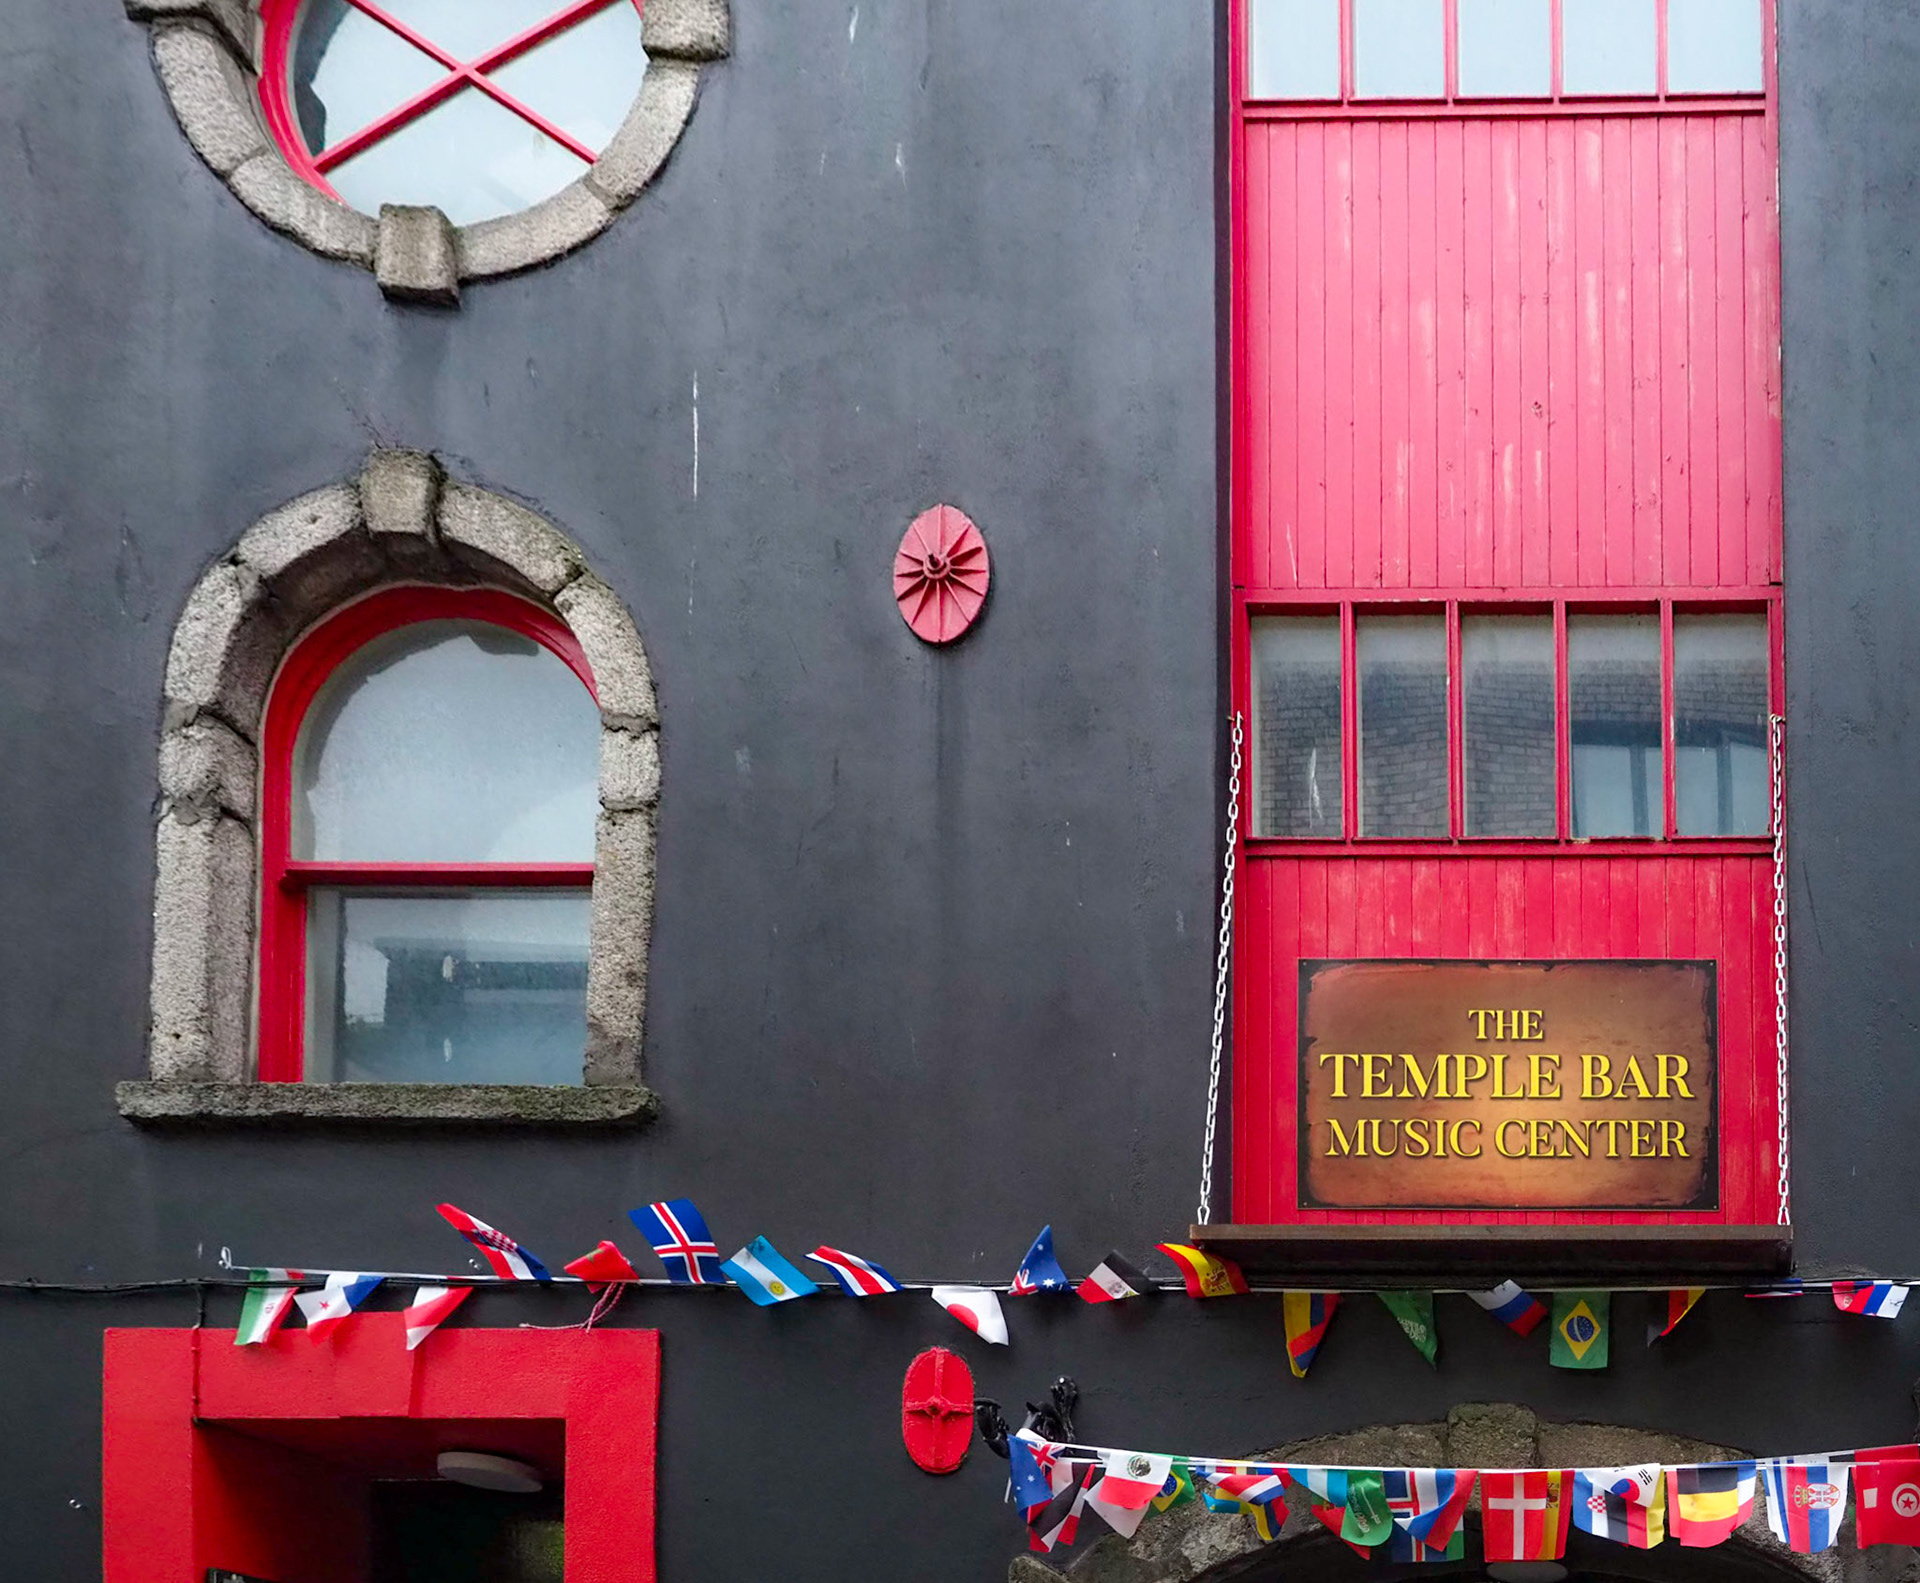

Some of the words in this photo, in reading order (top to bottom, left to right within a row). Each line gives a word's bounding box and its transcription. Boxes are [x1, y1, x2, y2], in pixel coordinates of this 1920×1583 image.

[1468, 1009, 1544, 1040] THE
[1319, 1053, 1561, 1099] TEMPLE
[1579, 1053, 1695, 1099] BAR
[1324, 1118, 1481, 1158] MUSIC
[1494, 1118, 1690, 1158] CENTER
